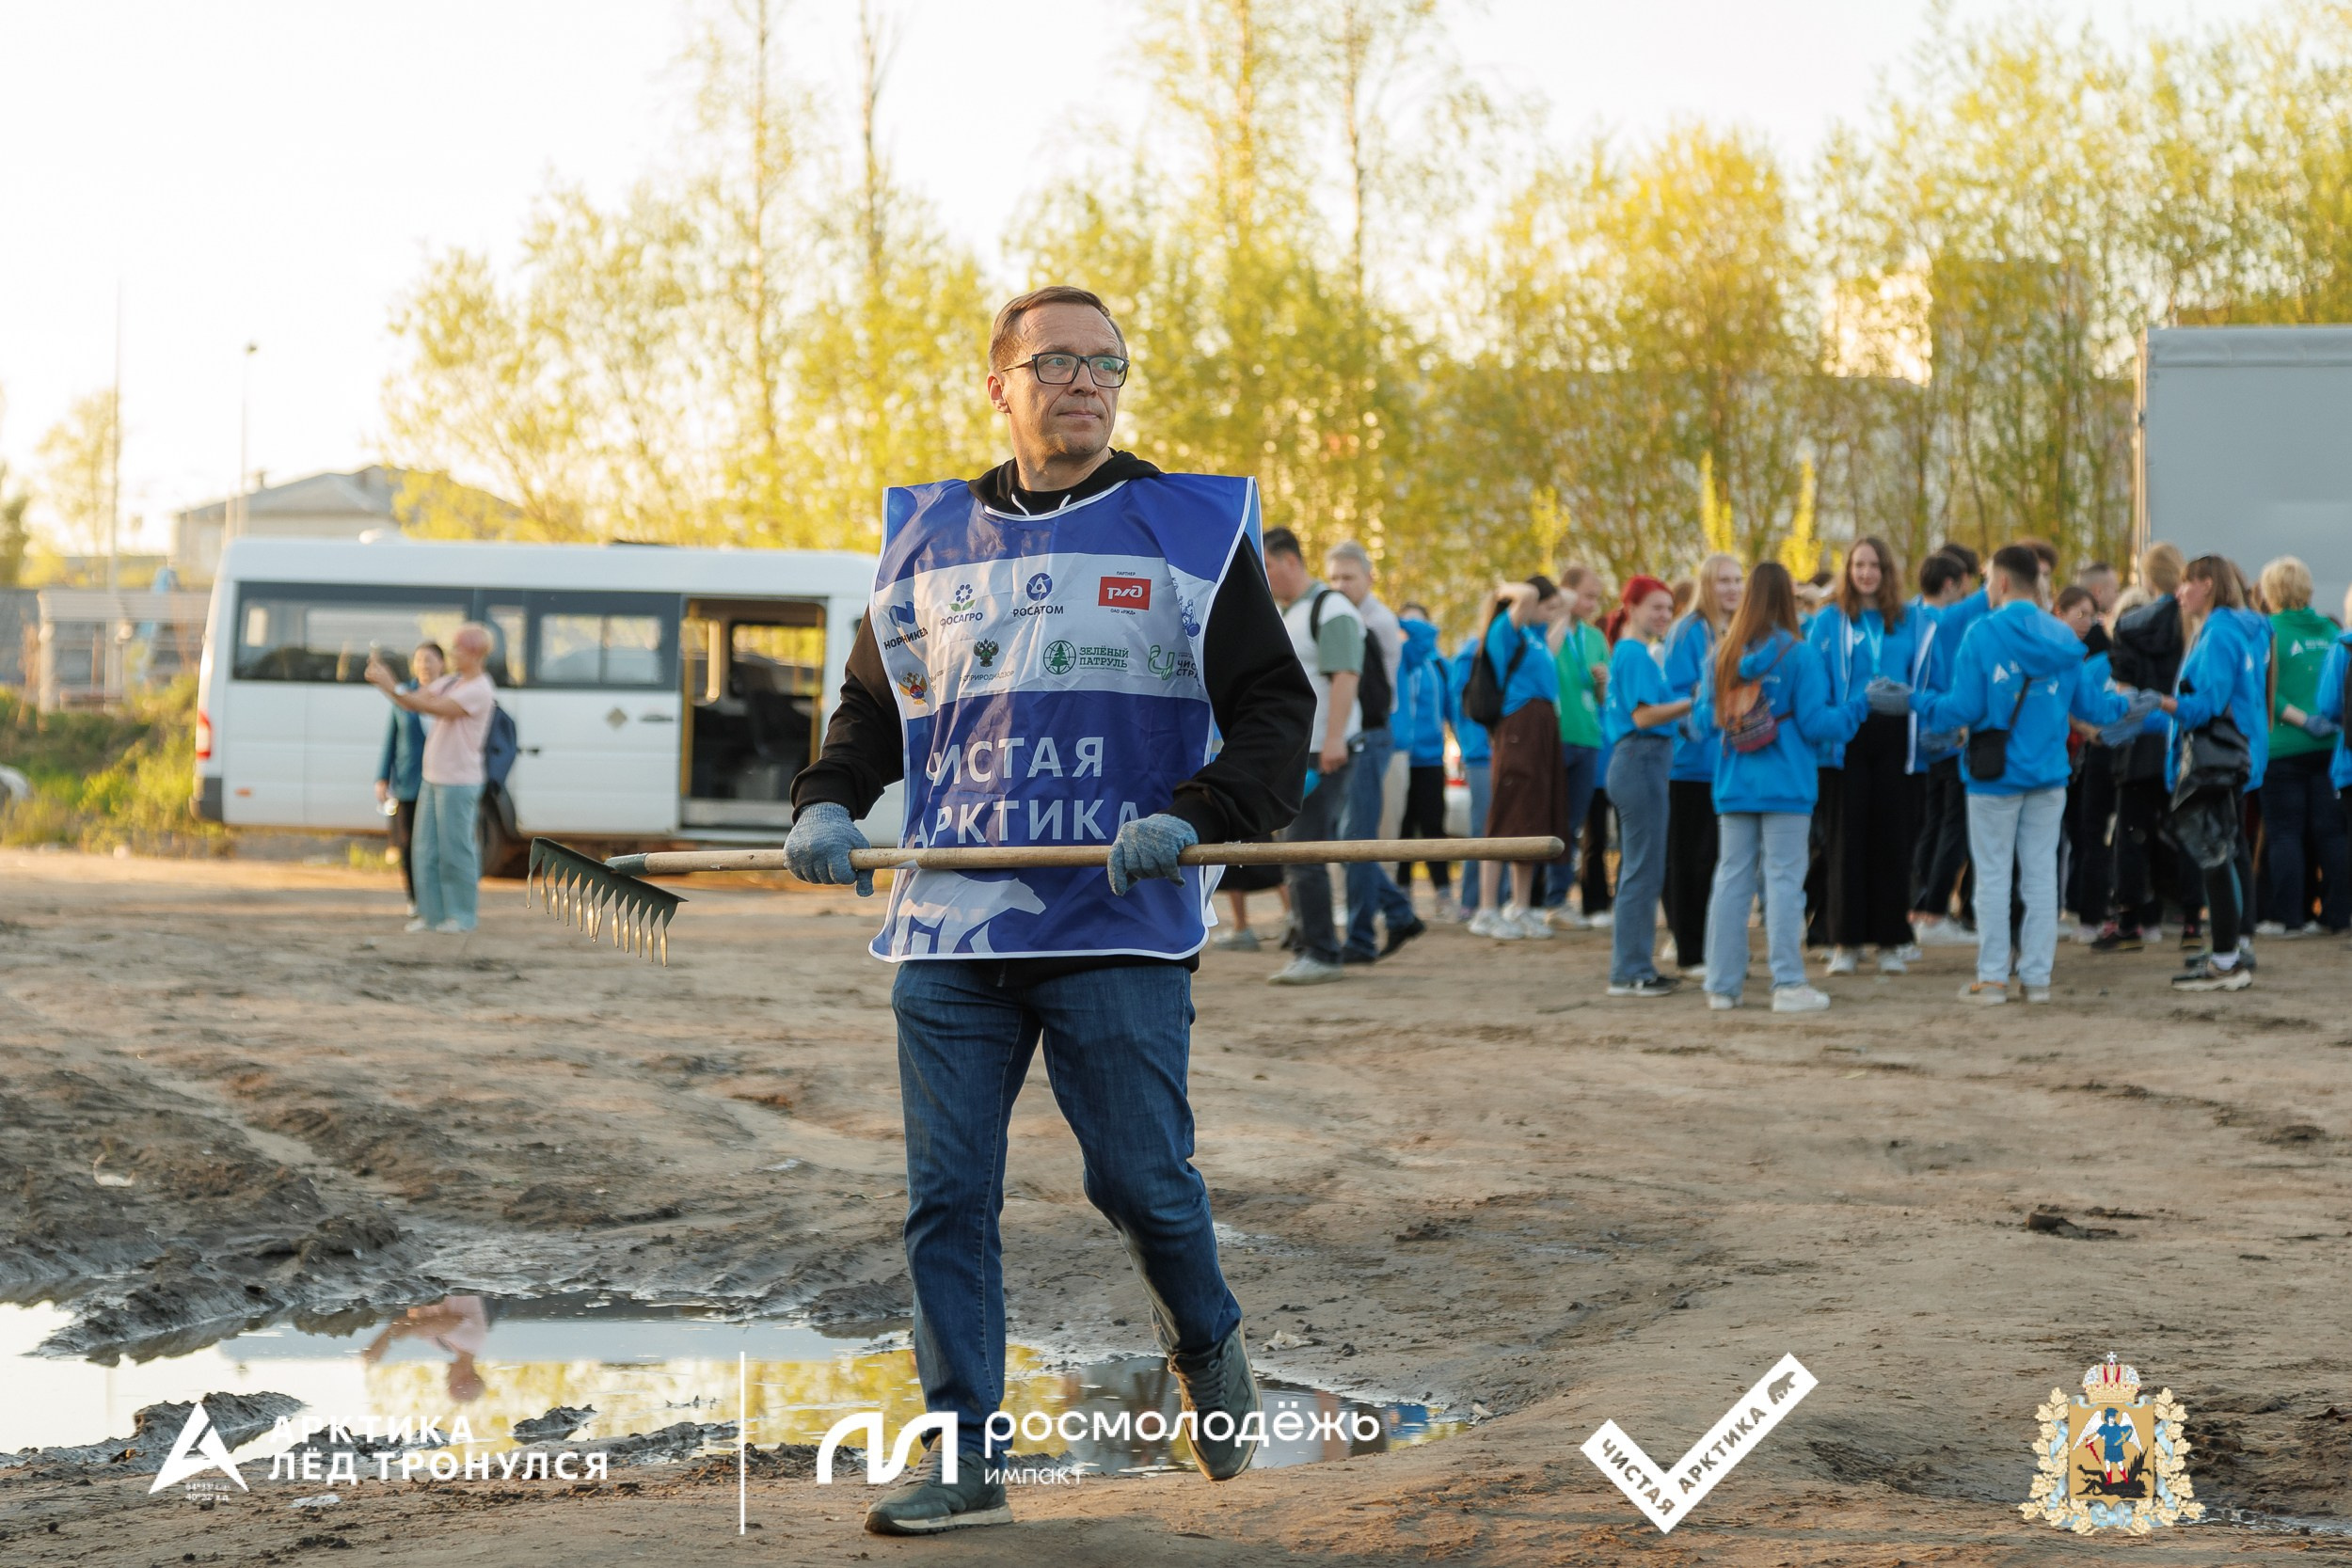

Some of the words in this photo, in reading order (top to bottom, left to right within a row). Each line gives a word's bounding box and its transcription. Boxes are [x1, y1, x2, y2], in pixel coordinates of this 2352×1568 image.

[1012, 605, 1064, 618] РОСАТОМ
[1079, 645, 1129, 657] ЗЕЛЁНЫЙ
[1079, 657, 1128, 668] ПАТРУЛЬ
